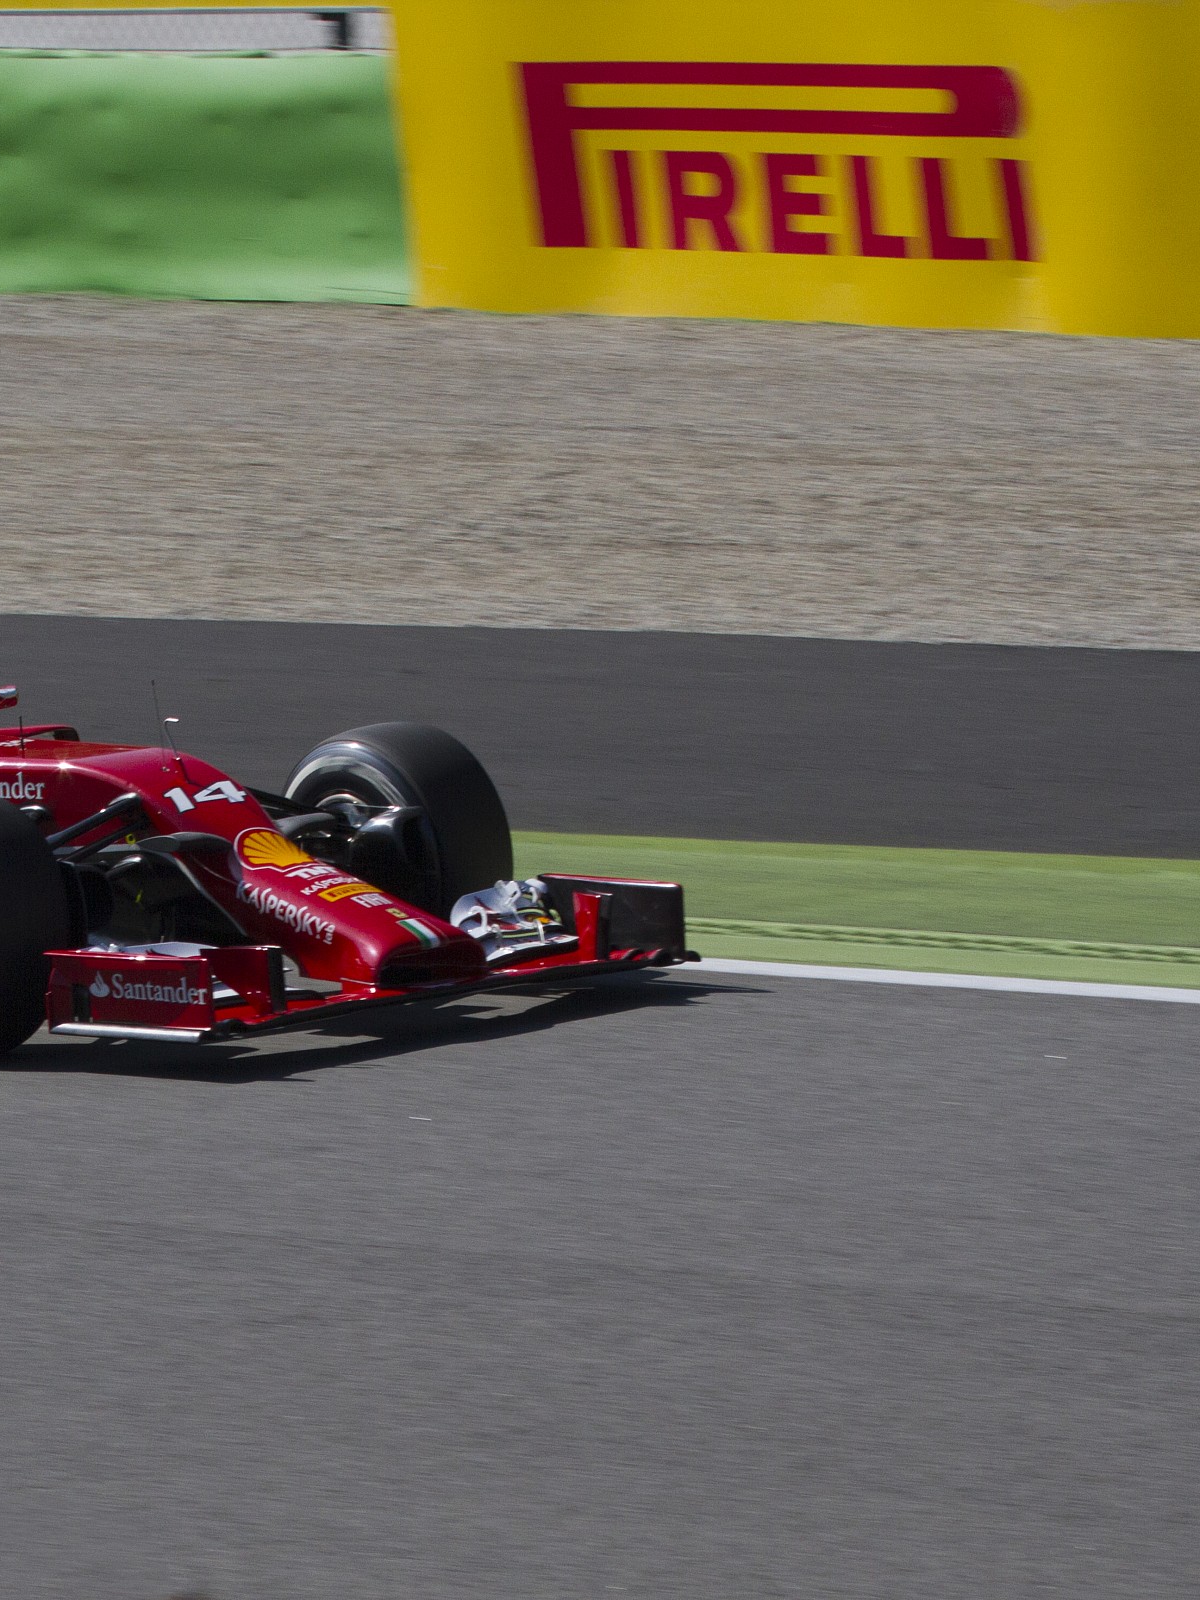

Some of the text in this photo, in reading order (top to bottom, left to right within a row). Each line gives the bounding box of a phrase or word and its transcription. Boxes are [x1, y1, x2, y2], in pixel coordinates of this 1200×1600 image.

[508, 60, 1042, 263] PIRELLI
[164, 780, 247, 813] 14
[236, 880, 328, 940] KASPERSKY
[350, 892, 393, 909] FIAT
[111, 973, 208, 1006] Santander
